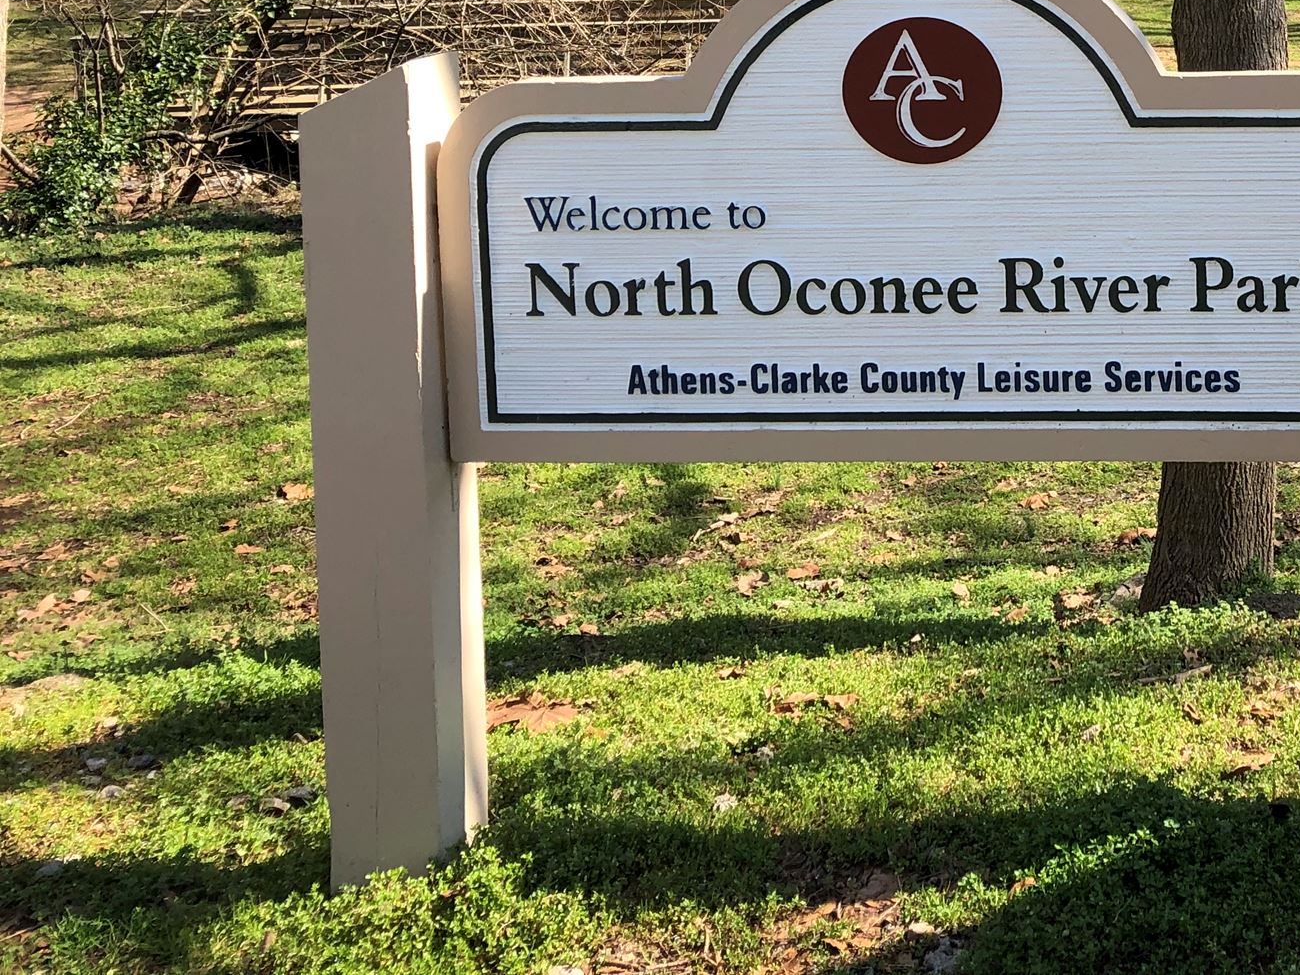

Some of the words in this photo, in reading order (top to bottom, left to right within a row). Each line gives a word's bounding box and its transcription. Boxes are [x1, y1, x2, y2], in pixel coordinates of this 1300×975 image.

[524, 196, 711, 232] Welcome
[727, 201, 767, 230] to
[524, 258, 718, 317] North
[737, 259, 979, 315] Oconee
[998, 256, 1170, 314] River
[627, 362, 848, 395] Athens-Clarke
[860, 362, 966, 400] County
[977, 362, 1092, 393] Leisure
[1104, 360, 1241, 393] Services
